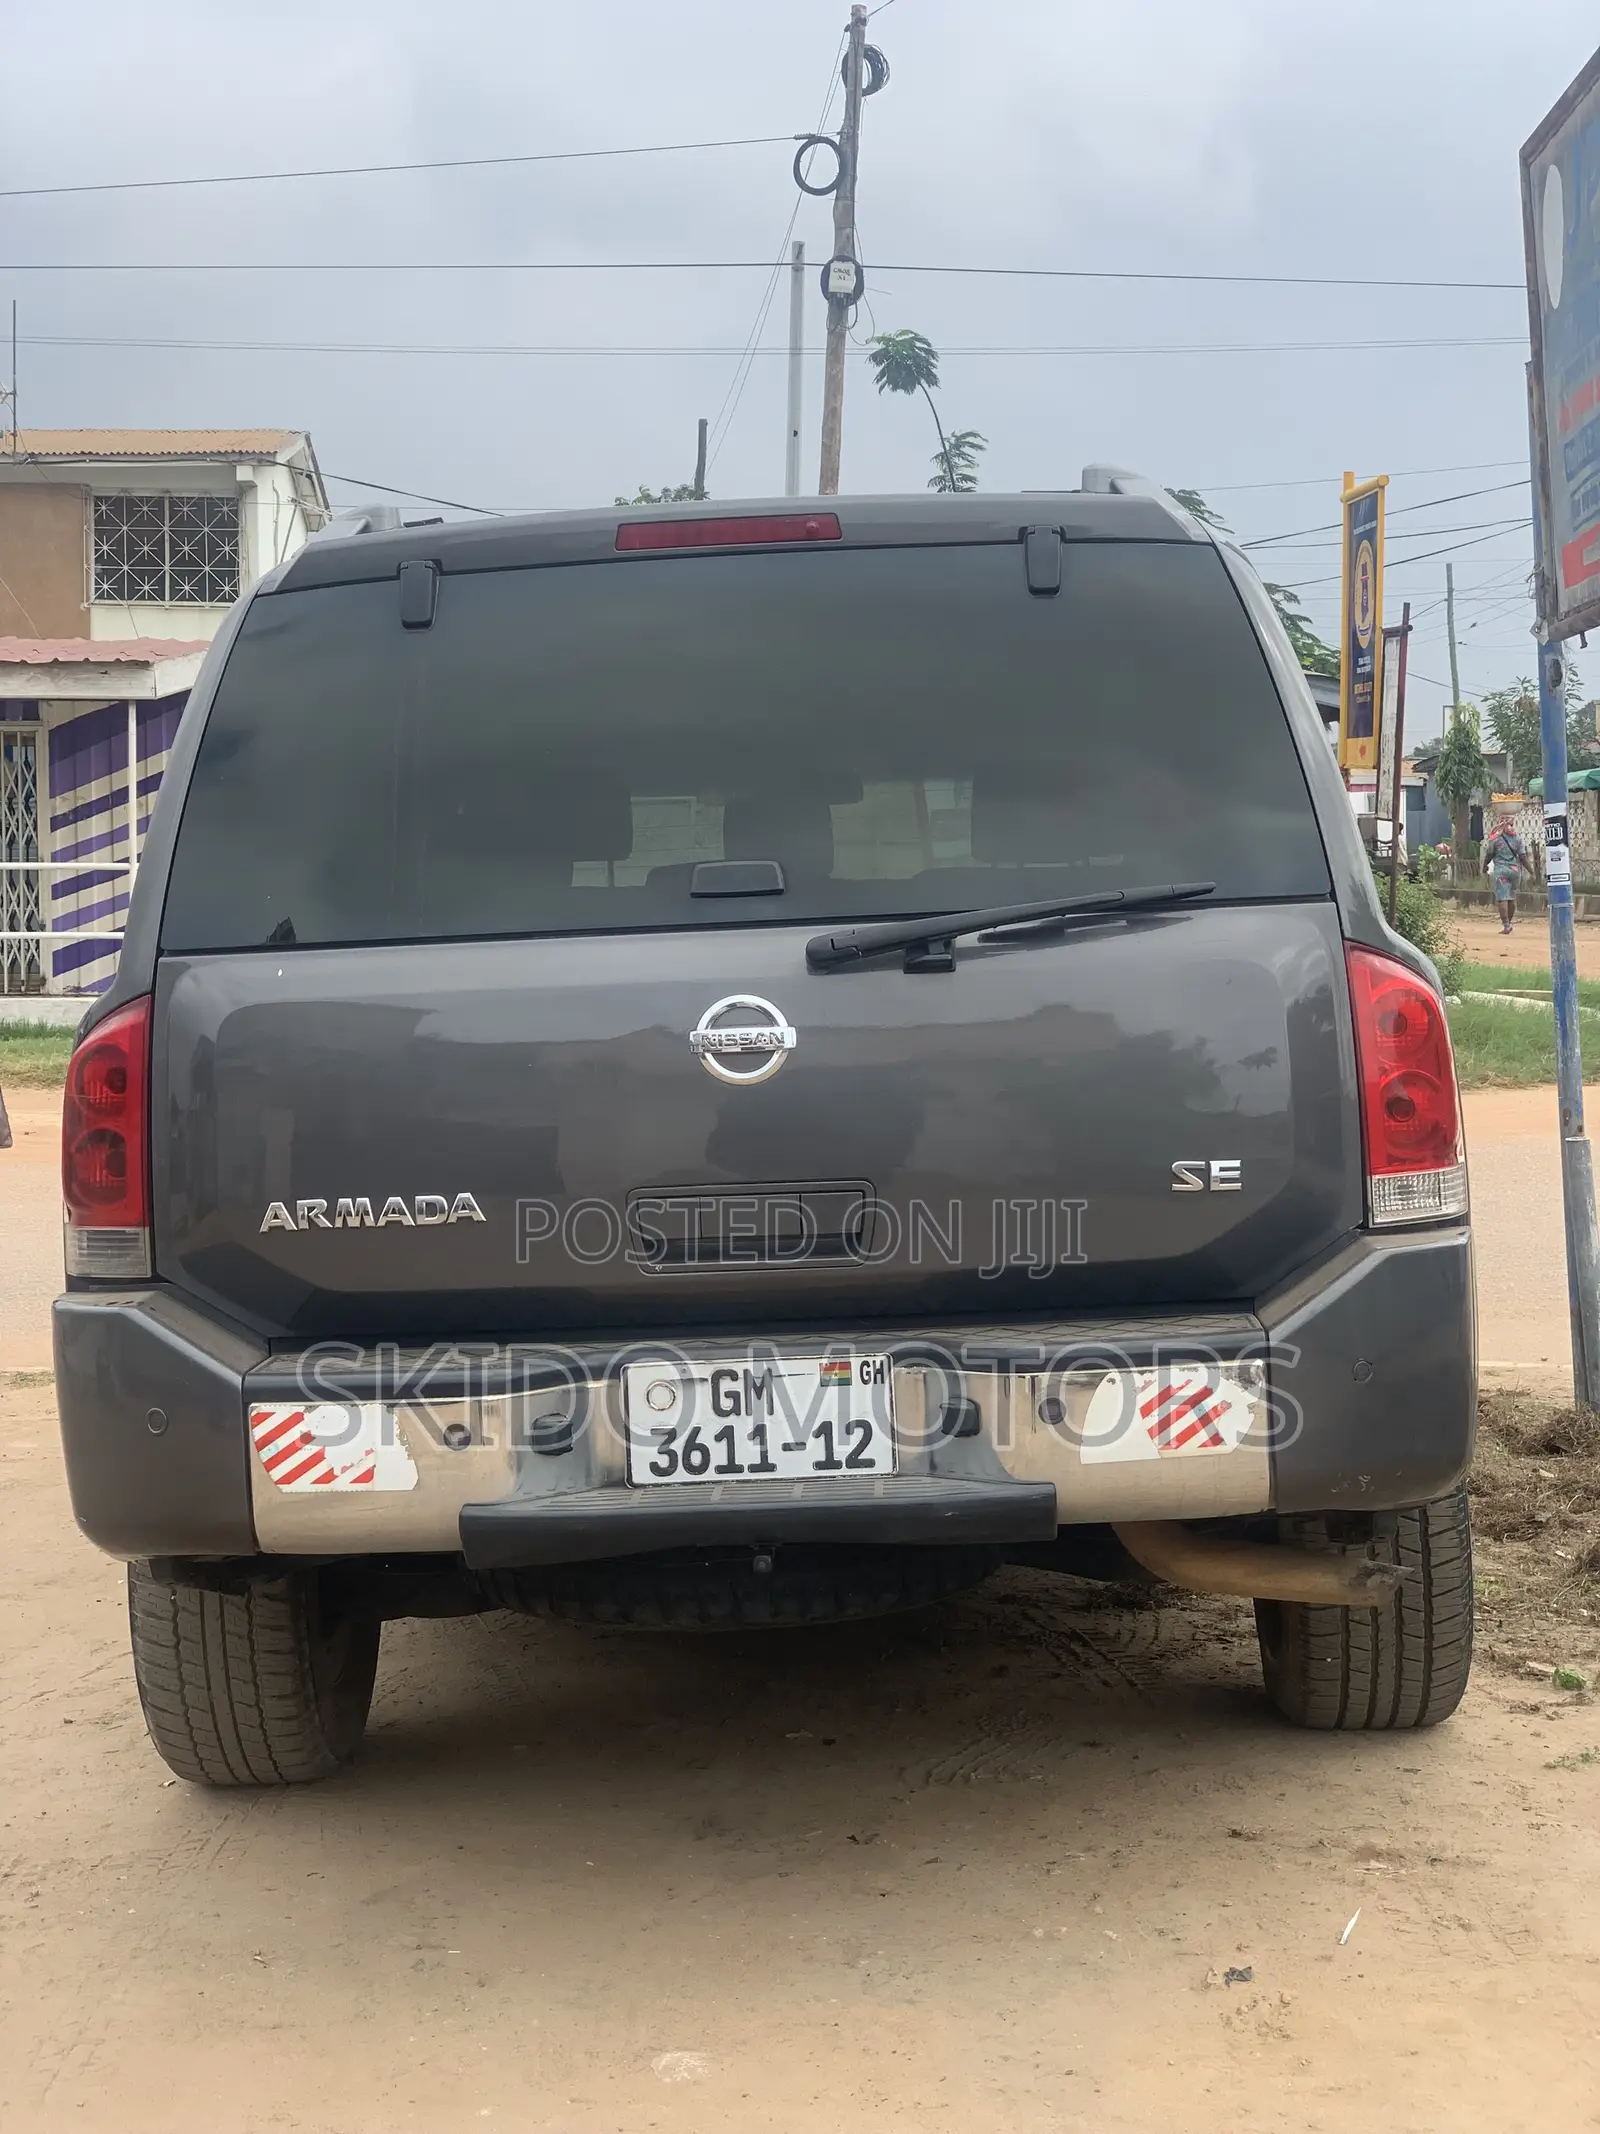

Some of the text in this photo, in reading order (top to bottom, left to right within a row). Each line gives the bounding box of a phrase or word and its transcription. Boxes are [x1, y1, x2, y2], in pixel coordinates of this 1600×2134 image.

[701, 1031, 785, 1049] NISSAN
[1171, 1158, 1243, 1192] SE
[259, 1192, 487, 1233] ARMADA
[710, 1359, 886, 1418] GM GH
[648, 1419, 876, 1478] 3611-12
